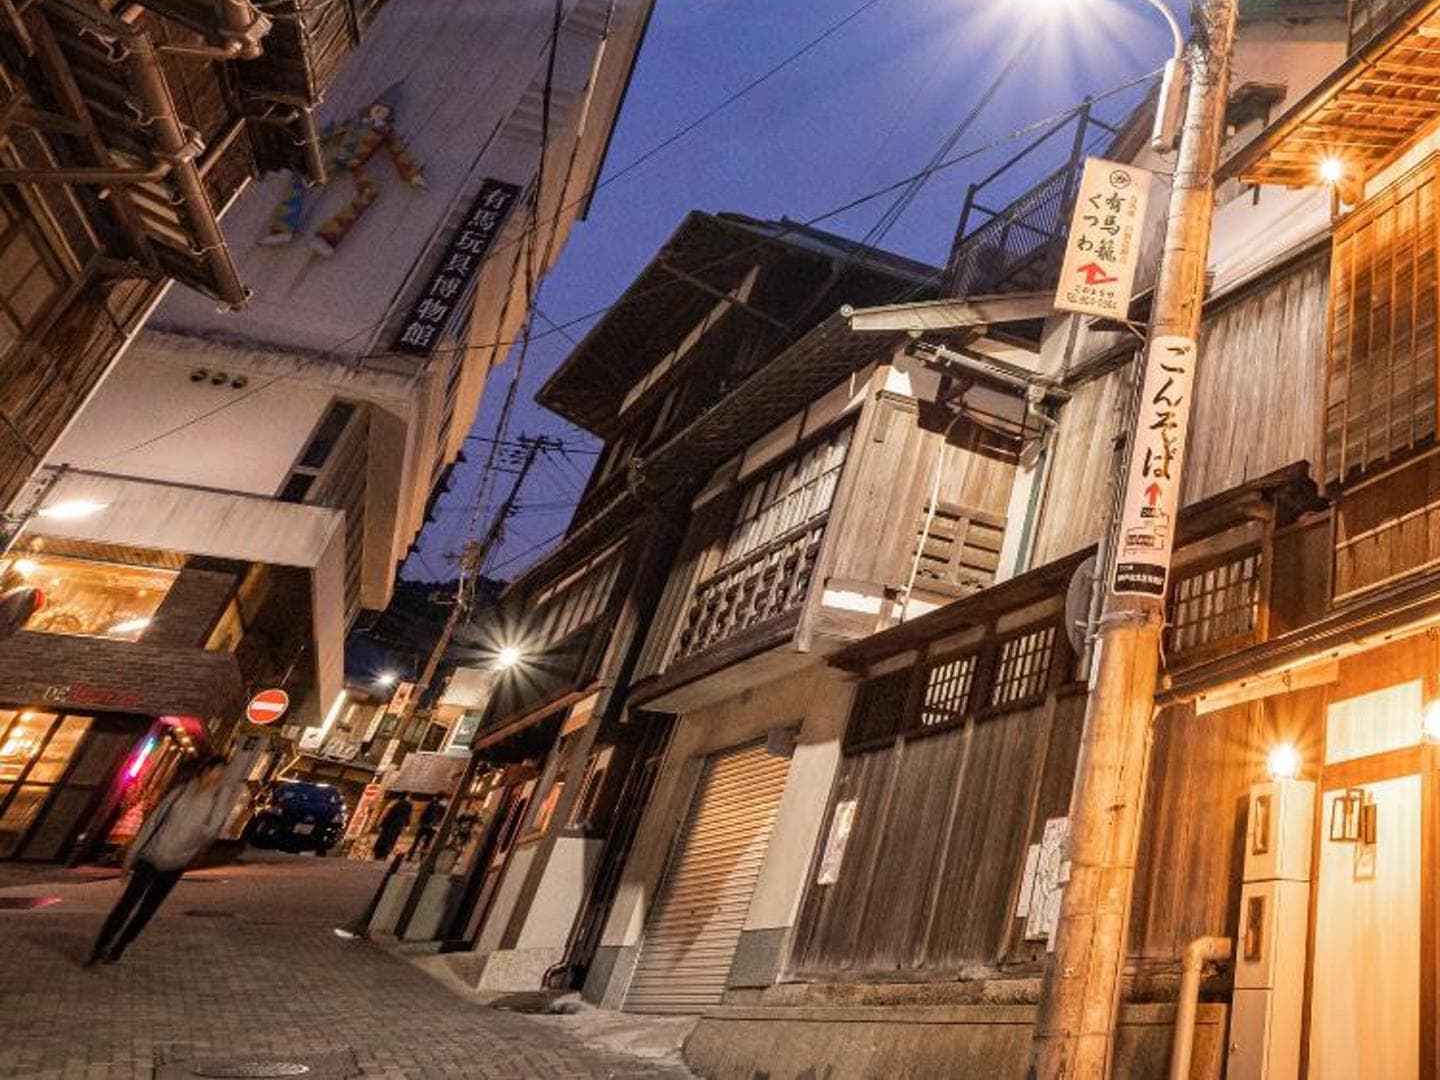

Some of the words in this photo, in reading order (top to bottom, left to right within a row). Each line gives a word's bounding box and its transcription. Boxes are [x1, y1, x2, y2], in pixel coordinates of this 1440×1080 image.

[401, 189, 510, 347] 有馬玩具博物館
[1077, 194, 1102, 251] くつわ
